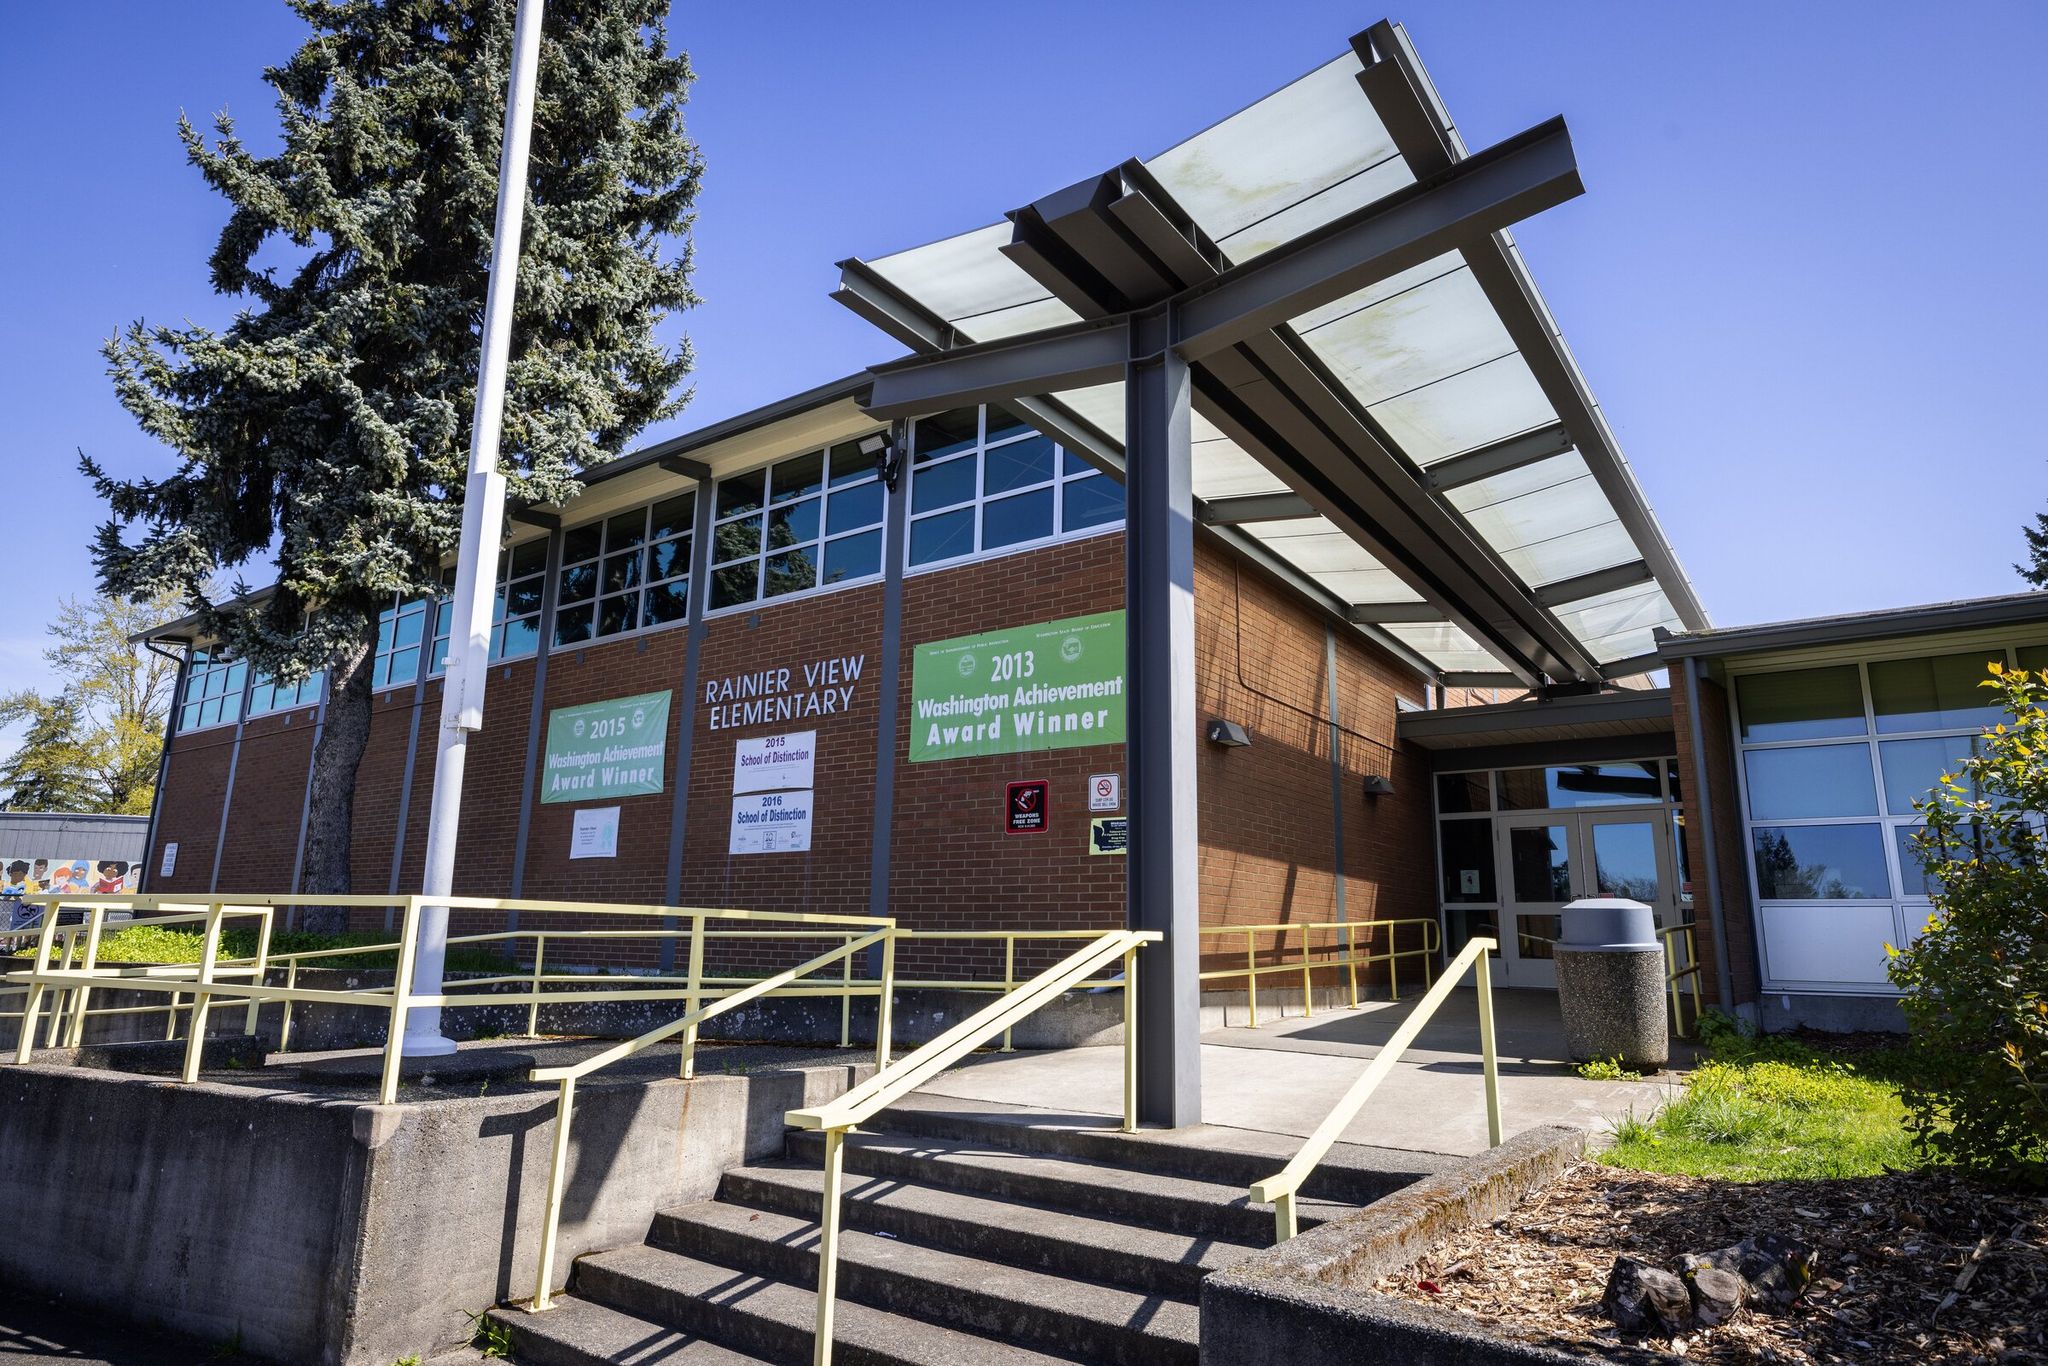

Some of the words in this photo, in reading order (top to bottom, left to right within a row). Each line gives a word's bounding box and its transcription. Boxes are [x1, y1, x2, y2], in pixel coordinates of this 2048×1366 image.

[705, 667, 790, 704] RAINIER
[803, 654, 865, 688] VIEW
[991, 650, 1034, 682] 2013
[709, 685, 855, 731] ELEMENTARY
[917, 692, 1009, 719] Washington
[1013, 676, 1123, 707] Achievement
[589, 717, 626, 739] 2015
[926, 714, 1001, 746] Award
[1013, 708, 1109, 737] Winner
[549, 751, 601, 769] Washington
[602, 742, 664, 762] Achievement
[765, 737, 785, 748] 2015
[740, 753, 763, 767] School
[764, 752, 771, 764] of
[772, 748, 809, 763] Distinction
[552, 769, 595, 791] Award
[602, 766, 654, 786] Winner
[762, 796, 782, 807] 2016
[737, 810, 760, 824] School
[761, 809, 768, 822] of
[769, 807, 807, 822] Distinction
